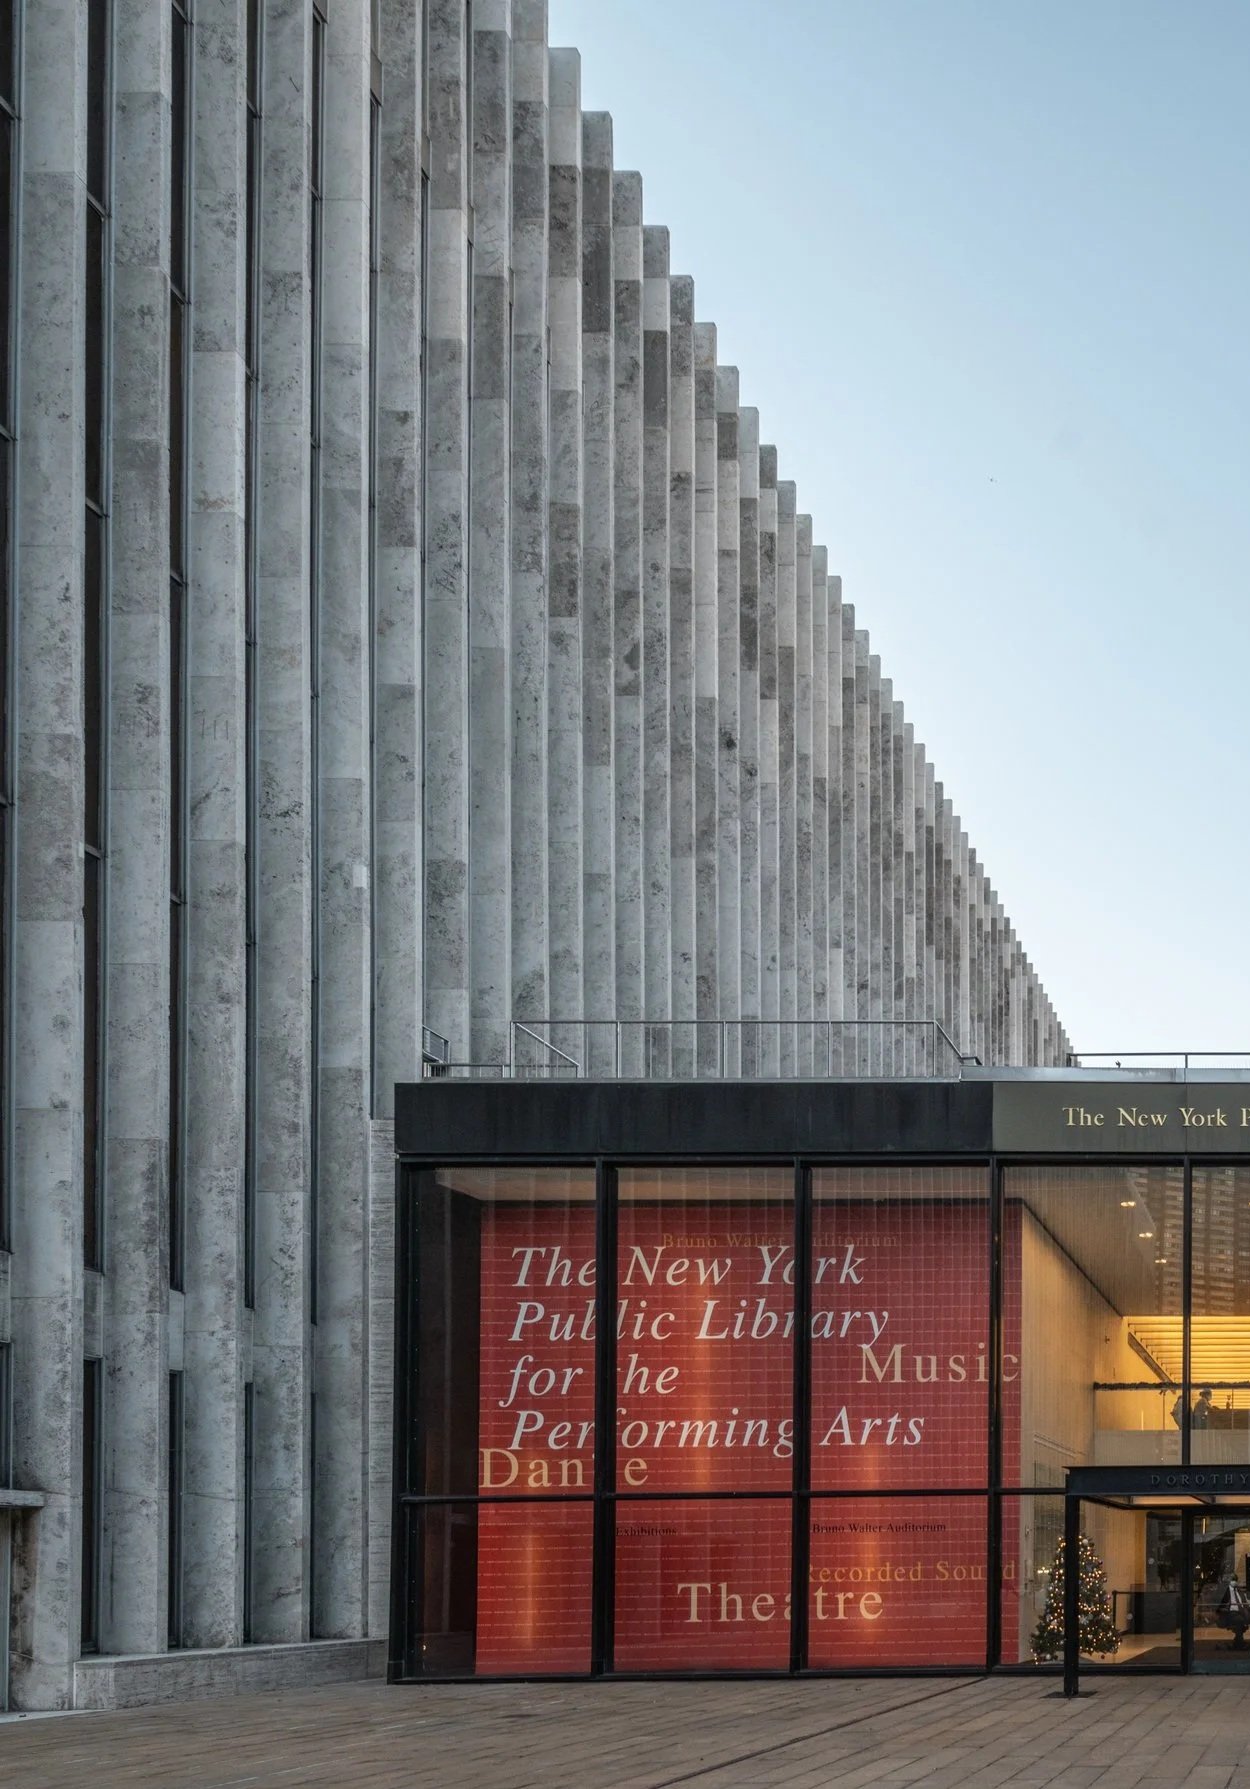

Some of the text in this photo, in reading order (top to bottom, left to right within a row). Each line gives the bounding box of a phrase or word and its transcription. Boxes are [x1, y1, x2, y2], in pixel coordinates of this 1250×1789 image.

[1062, 1107, 1105, 1127] The
[1117, 1107, 1168, 1127] New
[1179, 1107, 1228, 1127] York
[663, 1233, 717, 1248] Bruno
[726, 1233, 785, 1248] Walter
[511, 1246, 596, 1287] The
[622, 1246, 732, 1287] New
[857, 1343, 1018, 1383] Music
[498, 1353, 679, 1408] for he
[507, 1405, 925, 1458] Perorming Arts
[479, 1448, 649, 1488] Dane
[1151, 1472, 1249, 1486] DOROTHY
[812, 1522, 946, 1533] Bruno Walter Auditorium
[935, 1560, 1015, 1581] Soud
